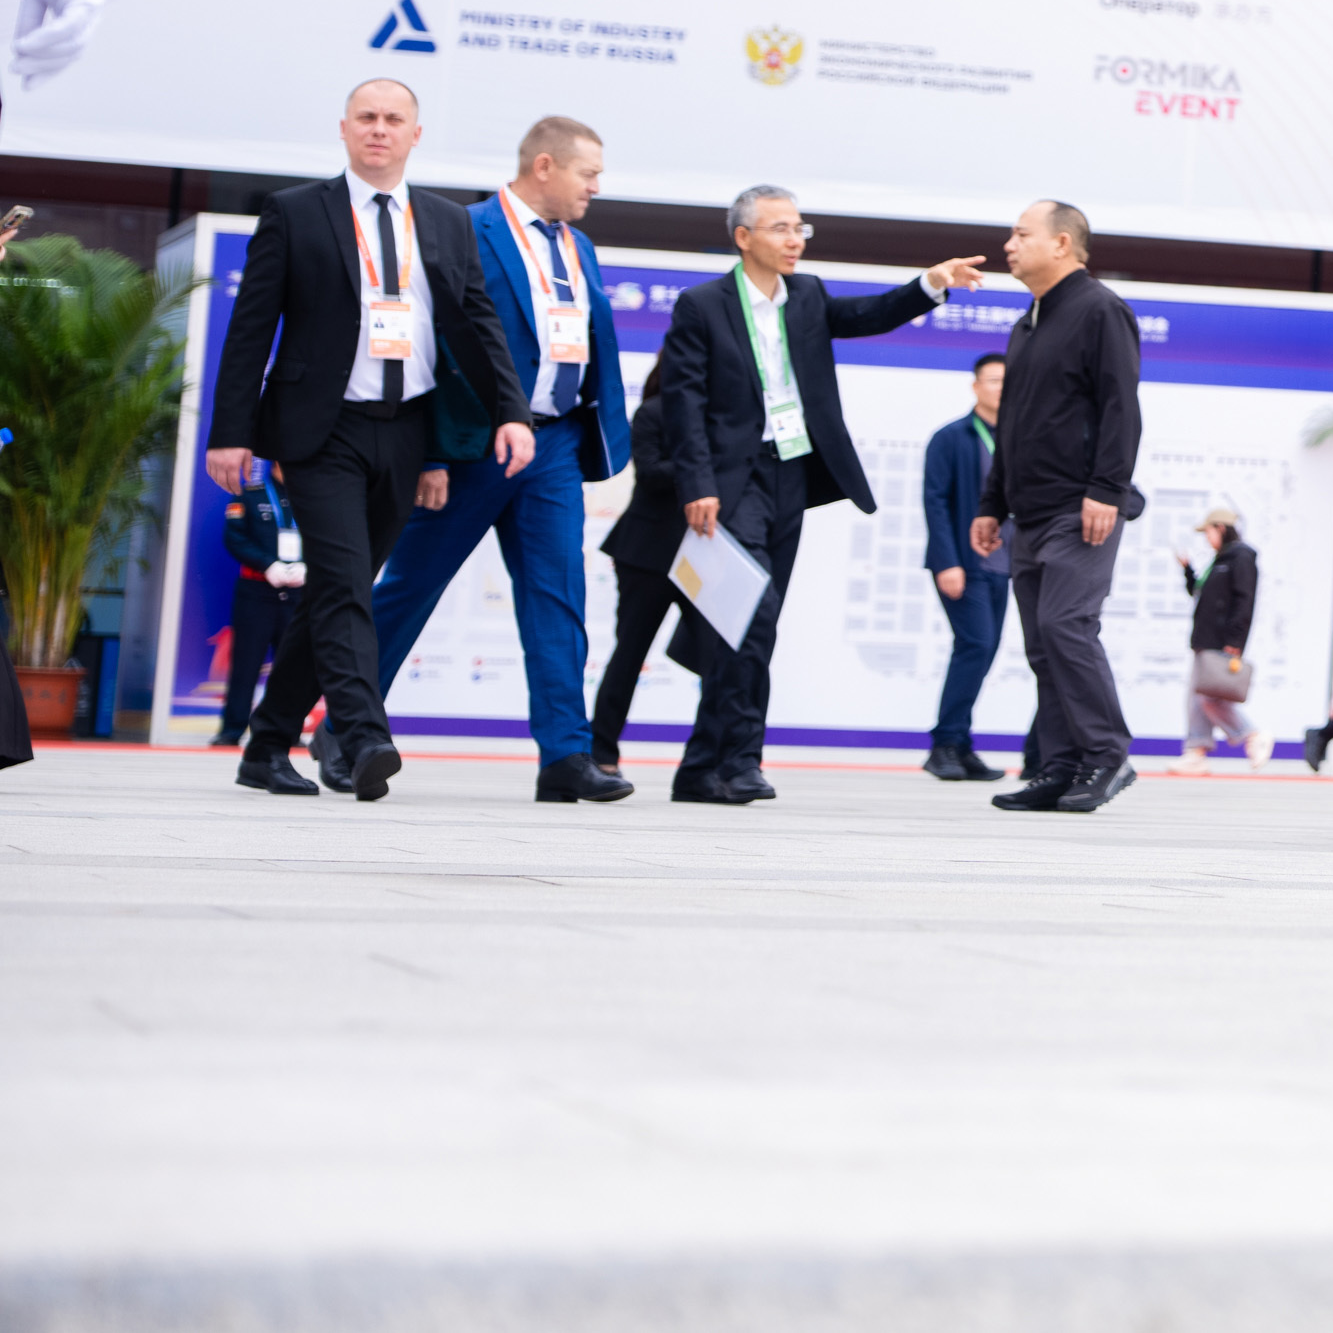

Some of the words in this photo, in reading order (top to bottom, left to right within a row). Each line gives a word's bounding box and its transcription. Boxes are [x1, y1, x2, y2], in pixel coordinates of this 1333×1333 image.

[458, 9, 553, 31] MINISTRY
[558, 16, 585, 33] OF
[590, 18, 688, 43] INDUSTRY
[457, 31, 501, 49] AND
[507, 35, 570, 55] TRADE
[575, 40, 602, 58] OF
[607, 43, 678, 64] RUSSIA
[1094, 54, 1243, 94] FORMIKA
[1135, 88, 1241, 121] EVENT
